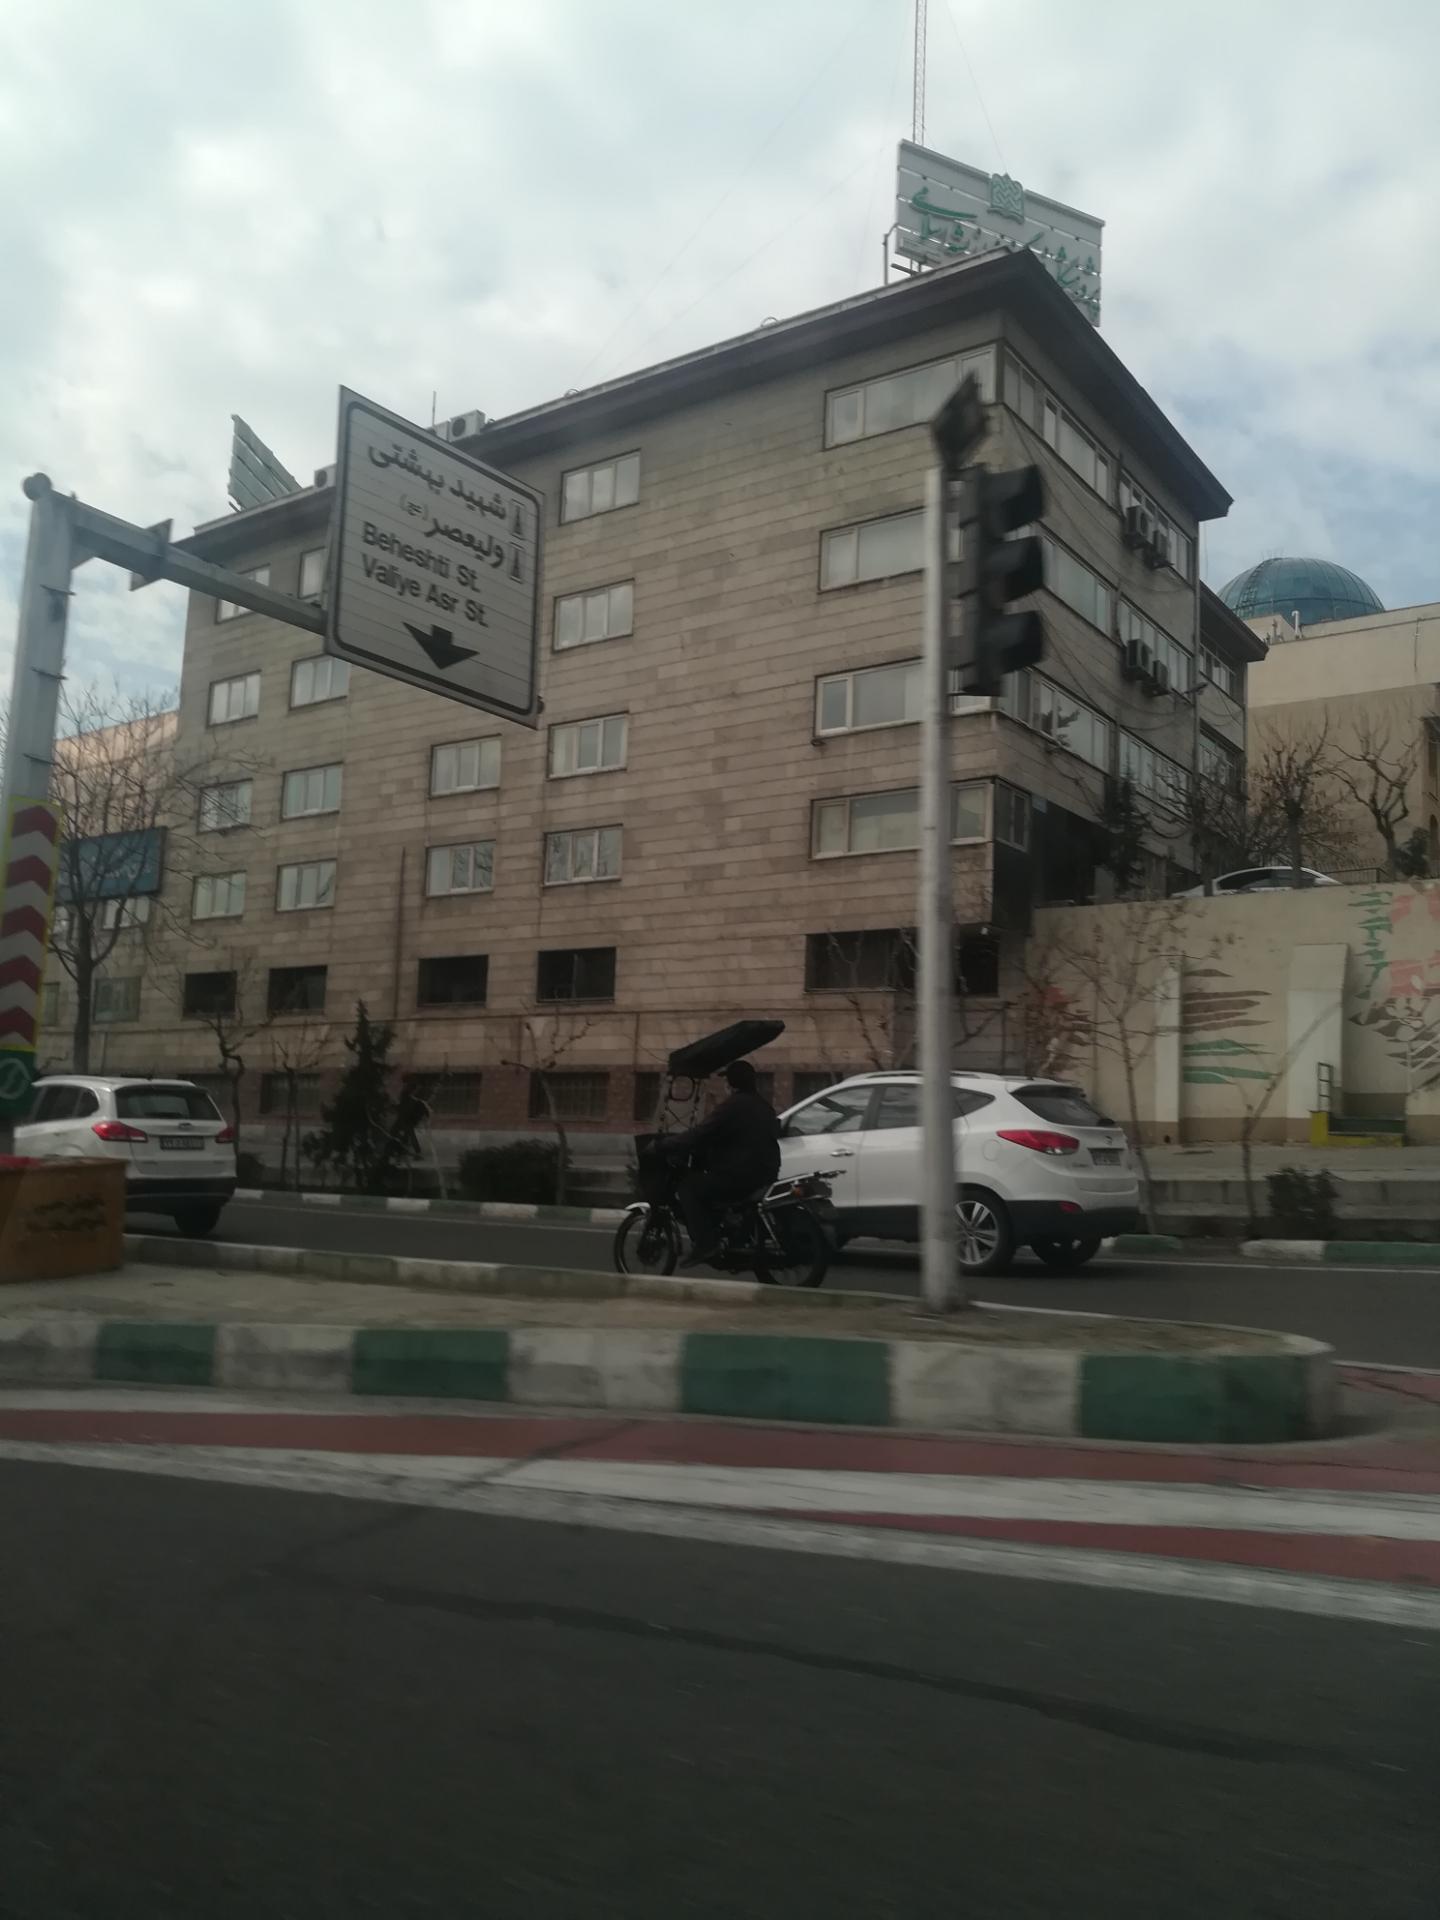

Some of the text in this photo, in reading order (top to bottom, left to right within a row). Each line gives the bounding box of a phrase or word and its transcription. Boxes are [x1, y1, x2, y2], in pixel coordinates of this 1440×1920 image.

[368, 444, 506, 520] شهید بهشتی
[362, 521, 450, 579] Beheshti
[424, 518, 504, 568] ولیعصر
[361, 552, 421, 597] Valiye
[426, 583, 459, 613] Asr
